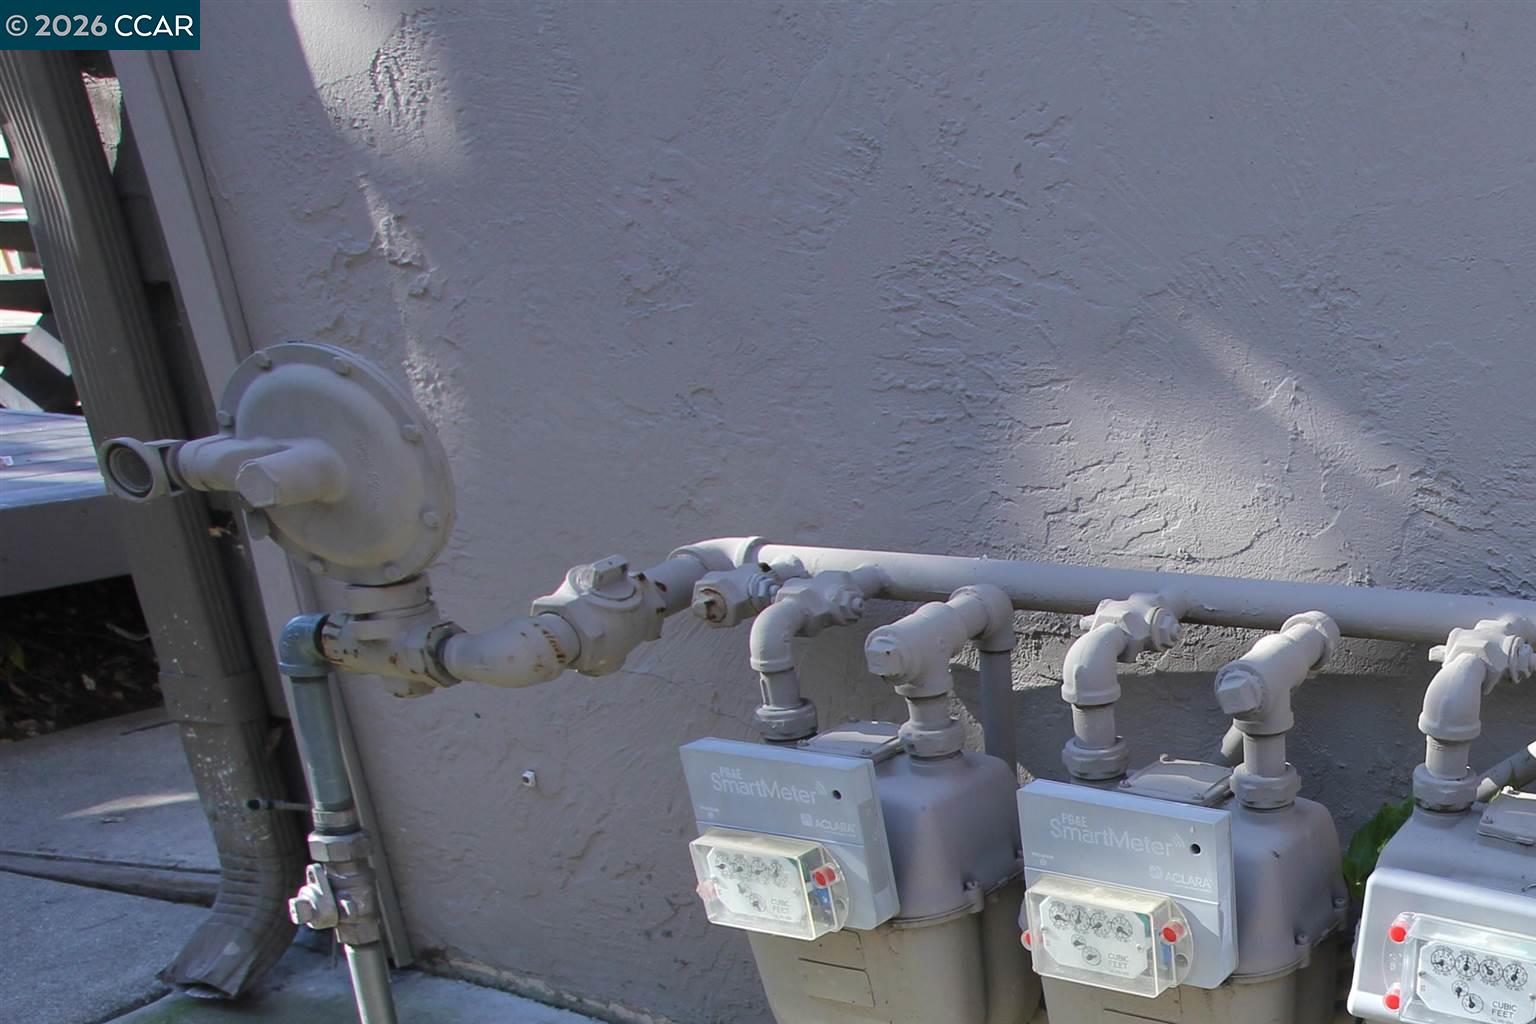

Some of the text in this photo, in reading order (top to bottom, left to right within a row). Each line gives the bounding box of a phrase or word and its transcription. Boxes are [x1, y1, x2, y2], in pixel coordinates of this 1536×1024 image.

[710, 772, 817, 805] SmartMeter
[1050, 817, 1175, 857] SmartMeter
[1165, 872, 1212, 889] ACLARA
[1491, 1008, 1515, 1019] FEET
[1492, 1000, 1518, 1013] CUBIC
